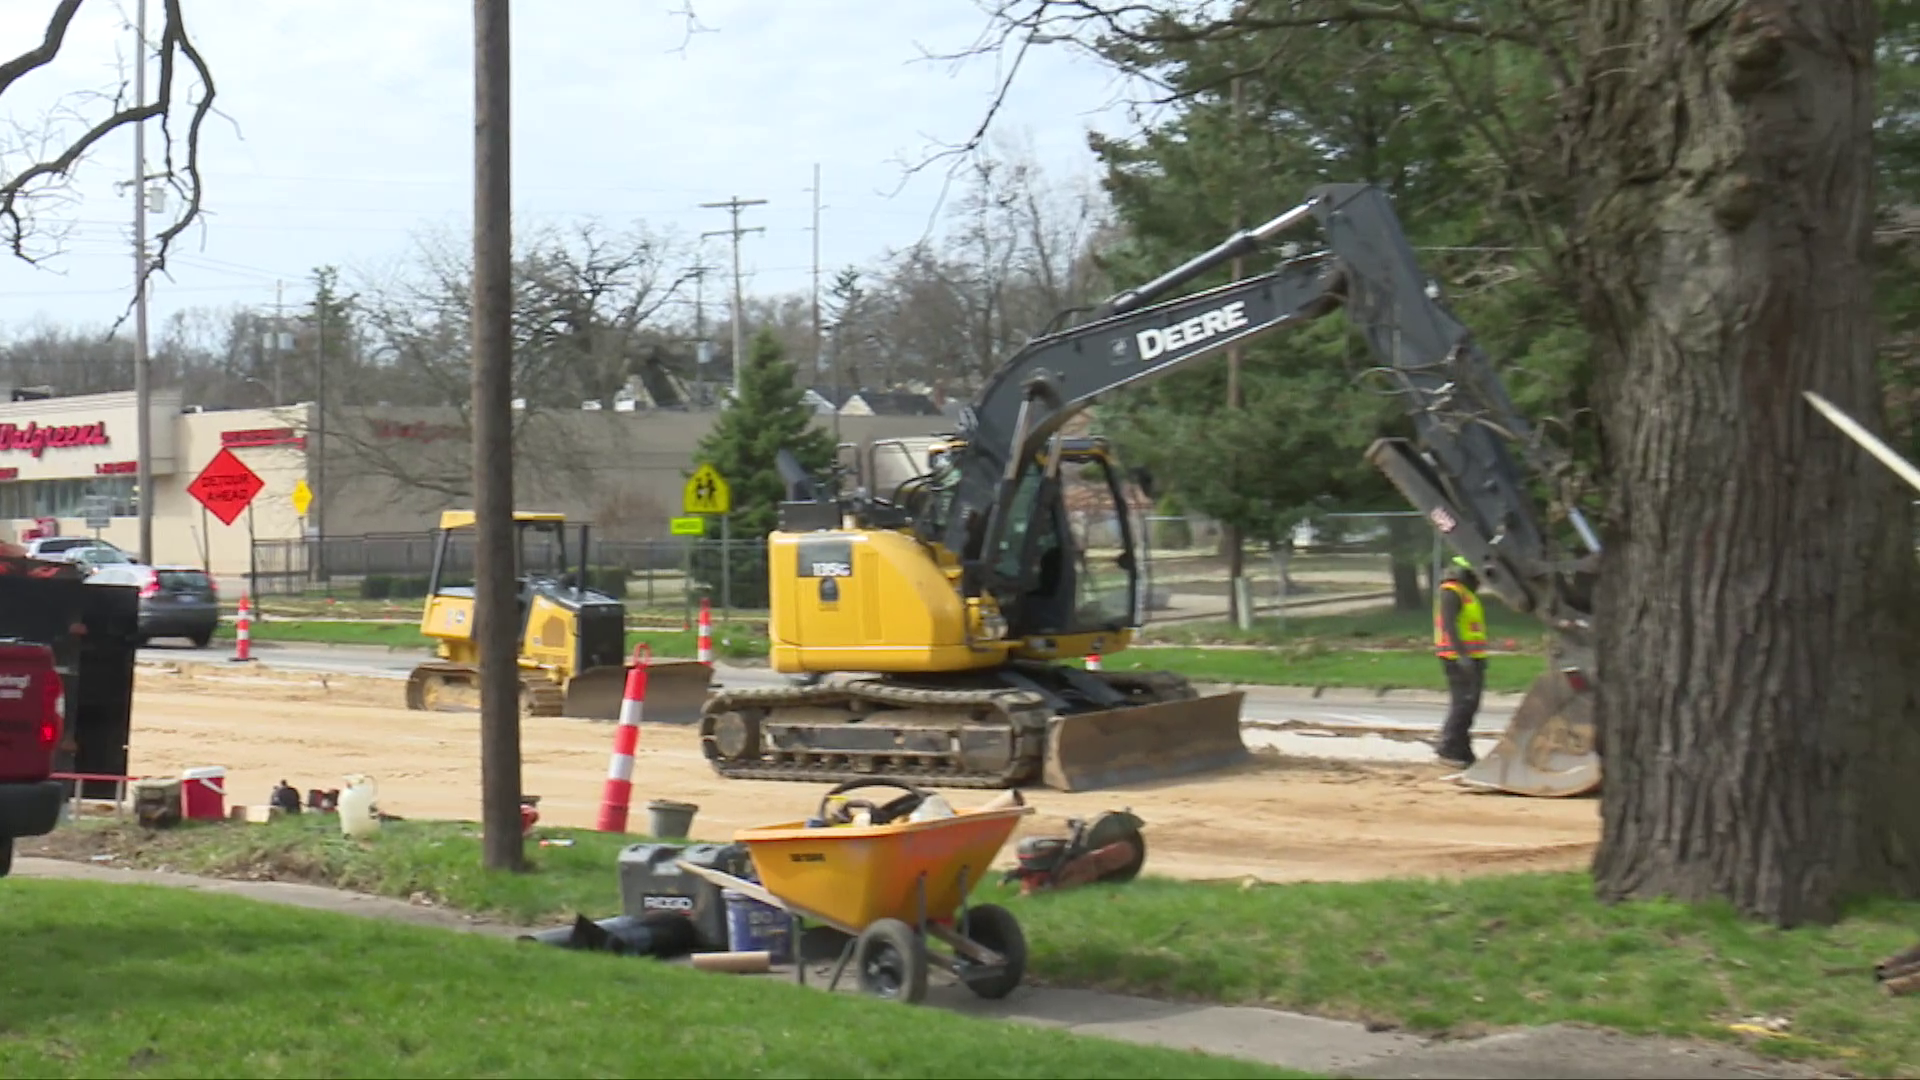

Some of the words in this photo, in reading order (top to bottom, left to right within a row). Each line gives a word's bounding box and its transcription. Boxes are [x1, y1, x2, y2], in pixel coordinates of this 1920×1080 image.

[1136, 300, 1248, 360] DEERE
[201, 473, 250, 488] DETOUR
[206, 488, 250, 502] AHEAD
